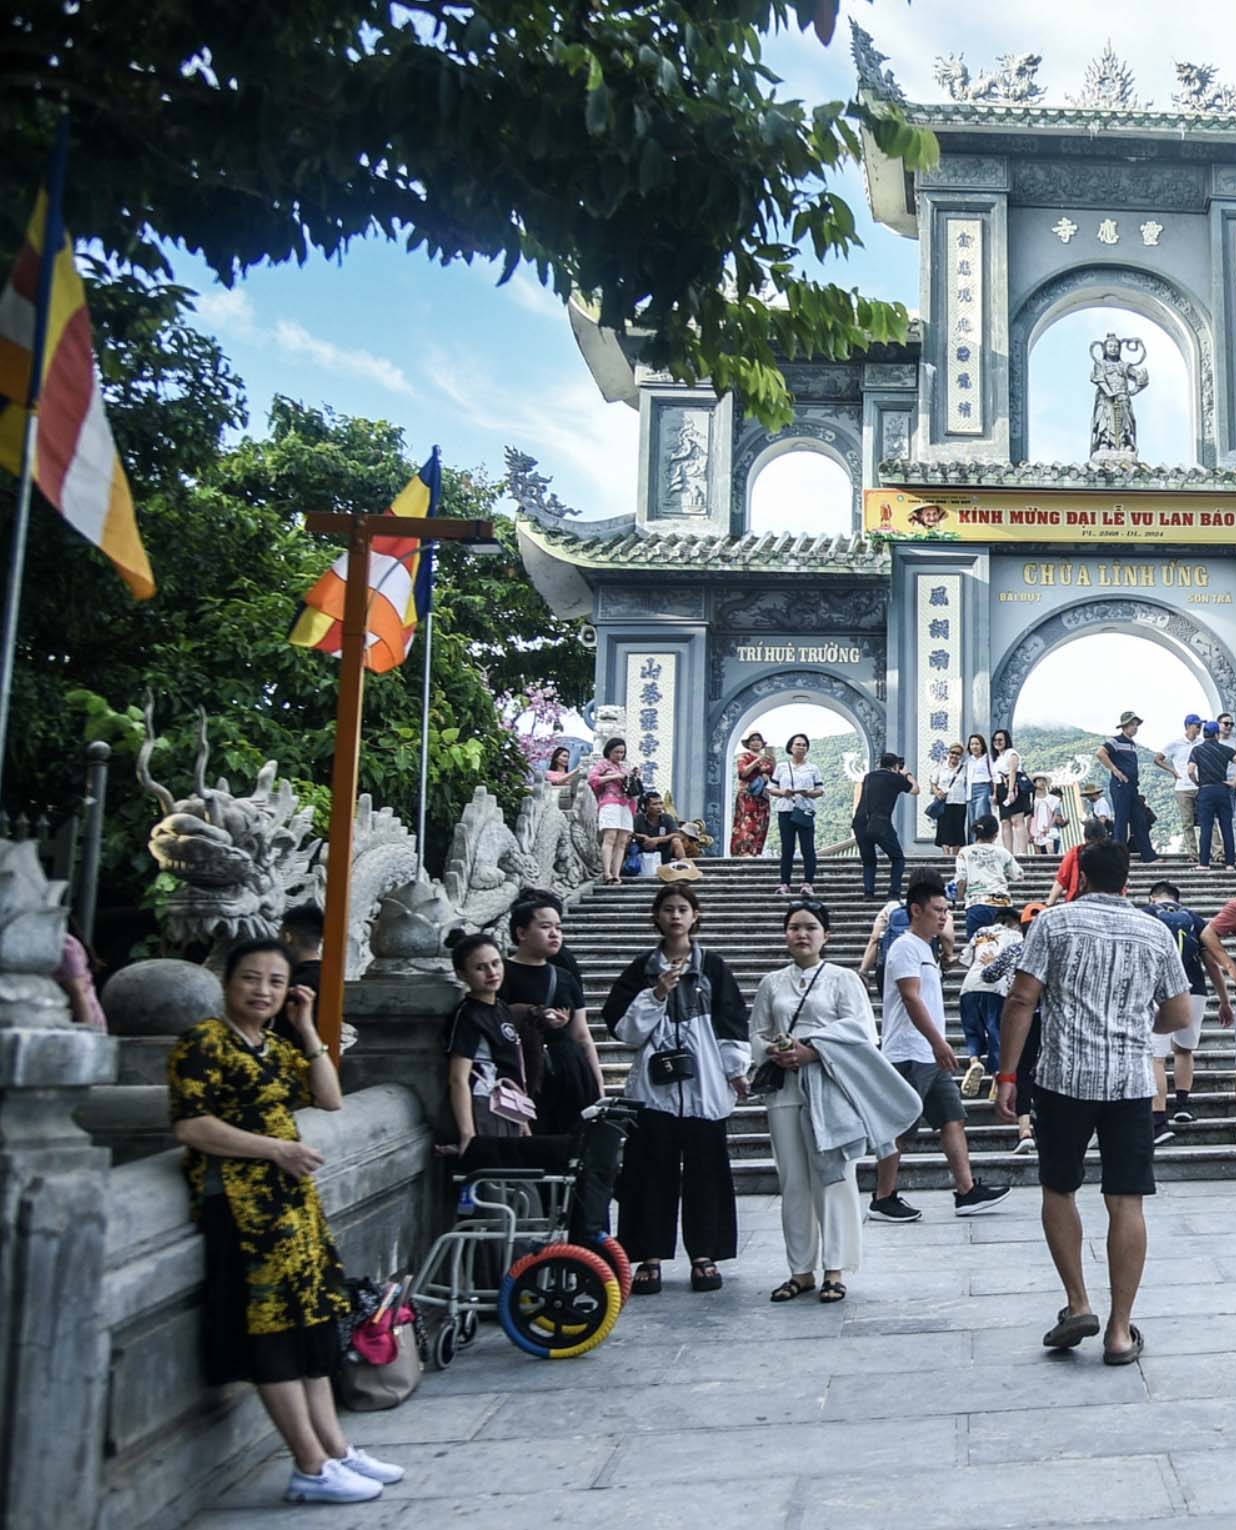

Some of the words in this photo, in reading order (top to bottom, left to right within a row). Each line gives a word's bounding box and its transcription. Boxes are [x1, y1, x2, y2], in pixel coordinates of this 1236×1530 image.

[958, 505, 1003, 525] KÍNH
[1009, 505, 1060, 526] MỪNG
[1066, 510, 1097, 530] ĐẠI
[1102, 504, 1125, 526] LỄ
[1130, 511, 1154, 526] VU
[1159, 512, 1194, 527] LAN
[1023, 559, 1091, 586] CHÙA
[1161, 559, 1210, 588] ỨNG
[736, 641, 763, 662] TRÍ
